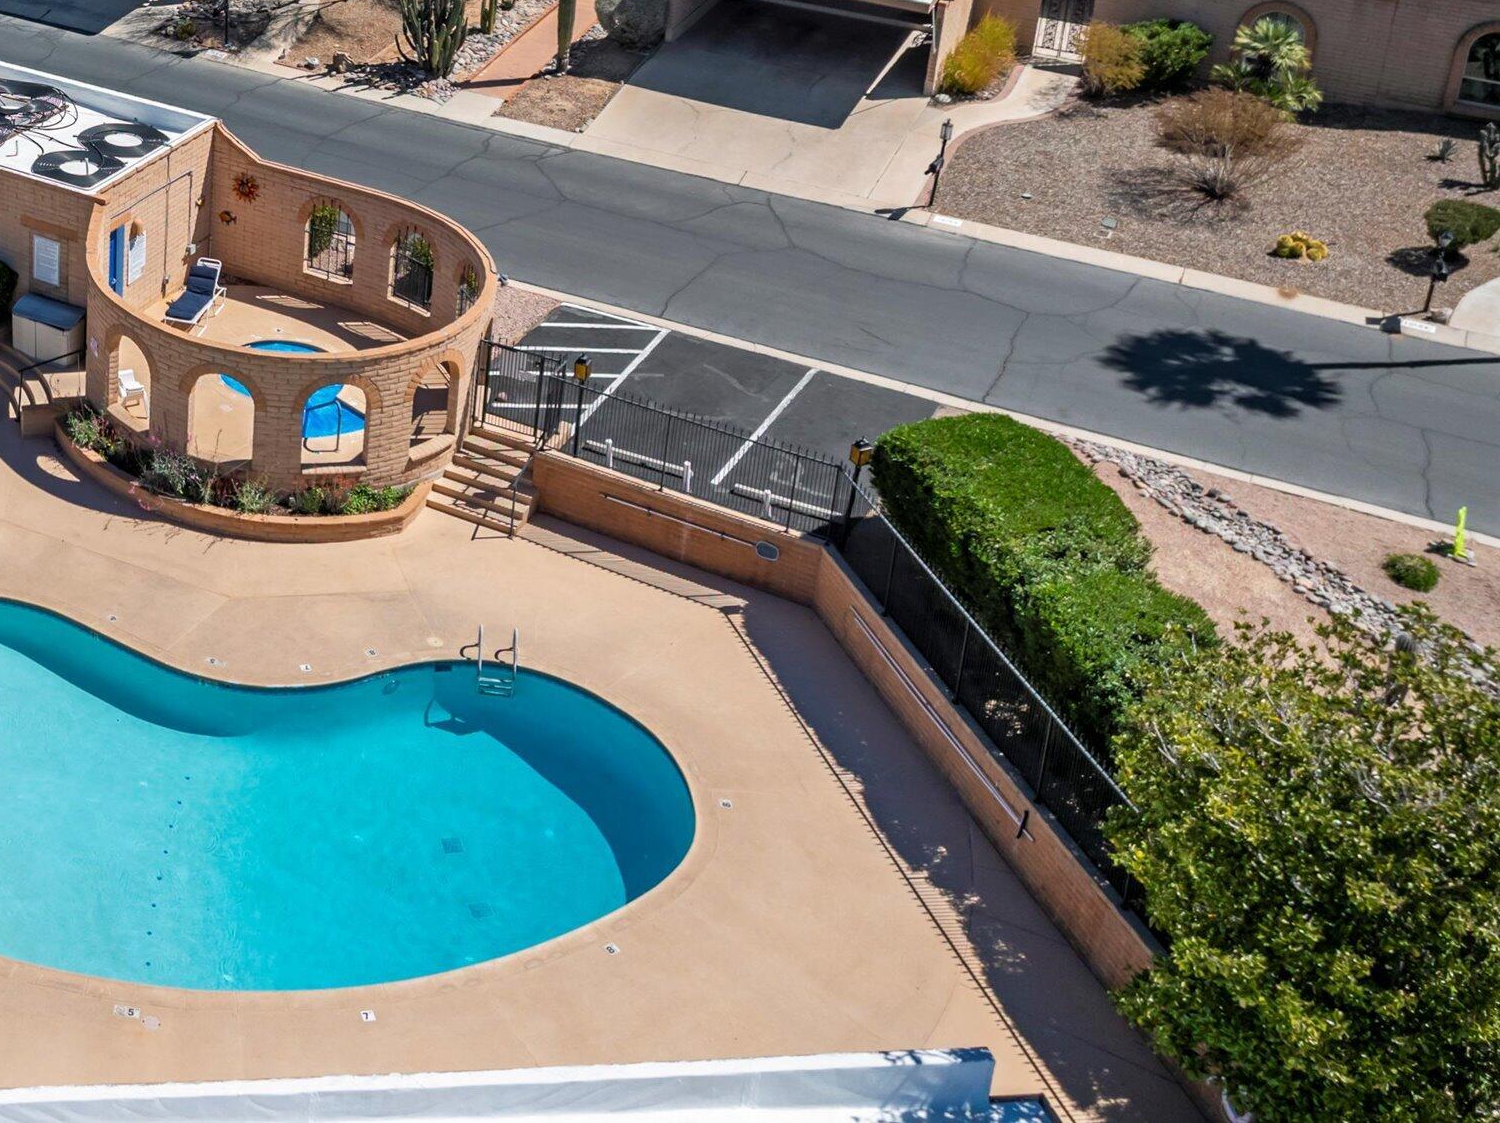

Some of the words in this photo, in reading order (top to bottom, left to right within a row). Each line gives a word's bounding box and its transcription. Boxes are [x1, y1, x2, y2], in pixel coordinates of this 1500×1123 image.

[606, 946, 615, 954] 8
[127, 1008, 135, 1016] 5
[362, 1012, 369, 1020] 7
